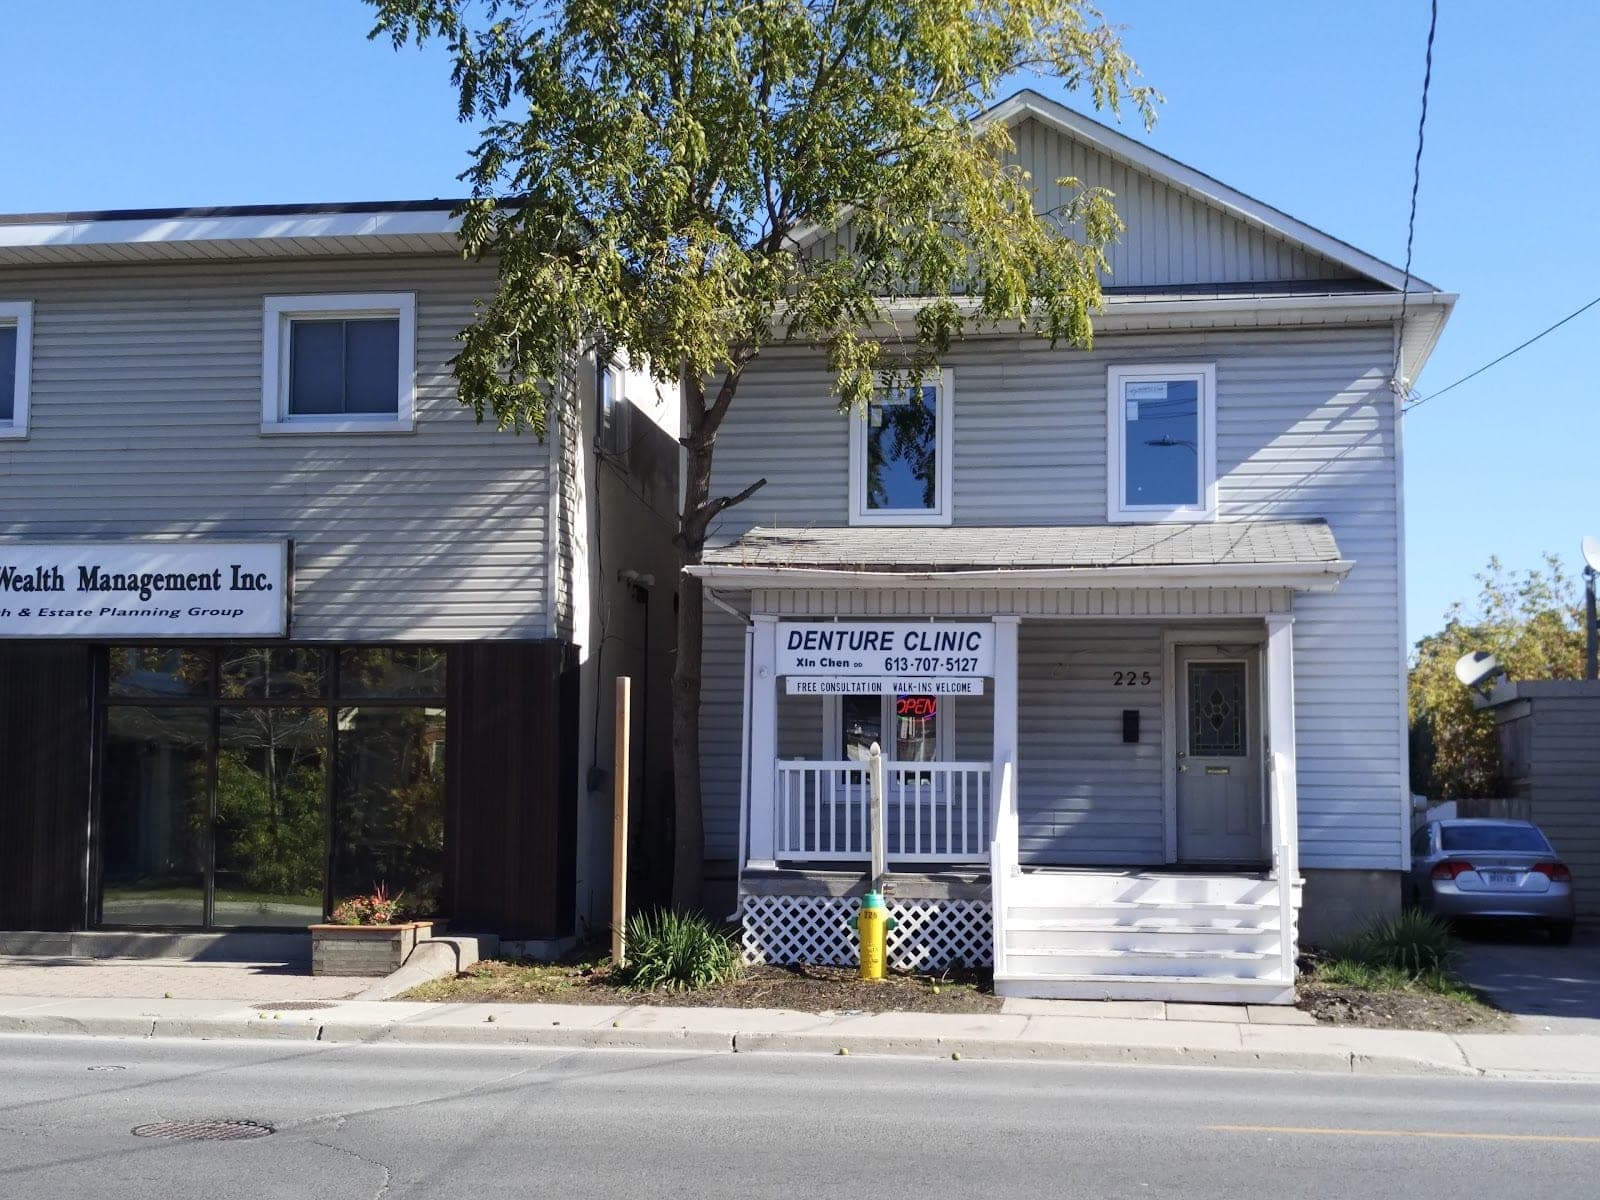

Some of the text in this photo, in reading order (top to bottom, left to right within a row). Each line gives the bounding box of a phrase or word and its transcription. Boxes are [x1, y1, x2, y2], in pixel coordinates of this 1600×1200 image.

[0, 564, 273, 601] Wealth Management Inc.
[0, 607, 244, 618] h & Estate Planning Group
[787, 630, 982, 651] DENTURE CLINIC
[820, 658, 849, 667] Chen
[1113, 671, 1152, 686] 225
[797, 682, 972, 692] FREE CONSULTATION WALK-INS WELCOME
[897, 698, 936, 714] OPEN
